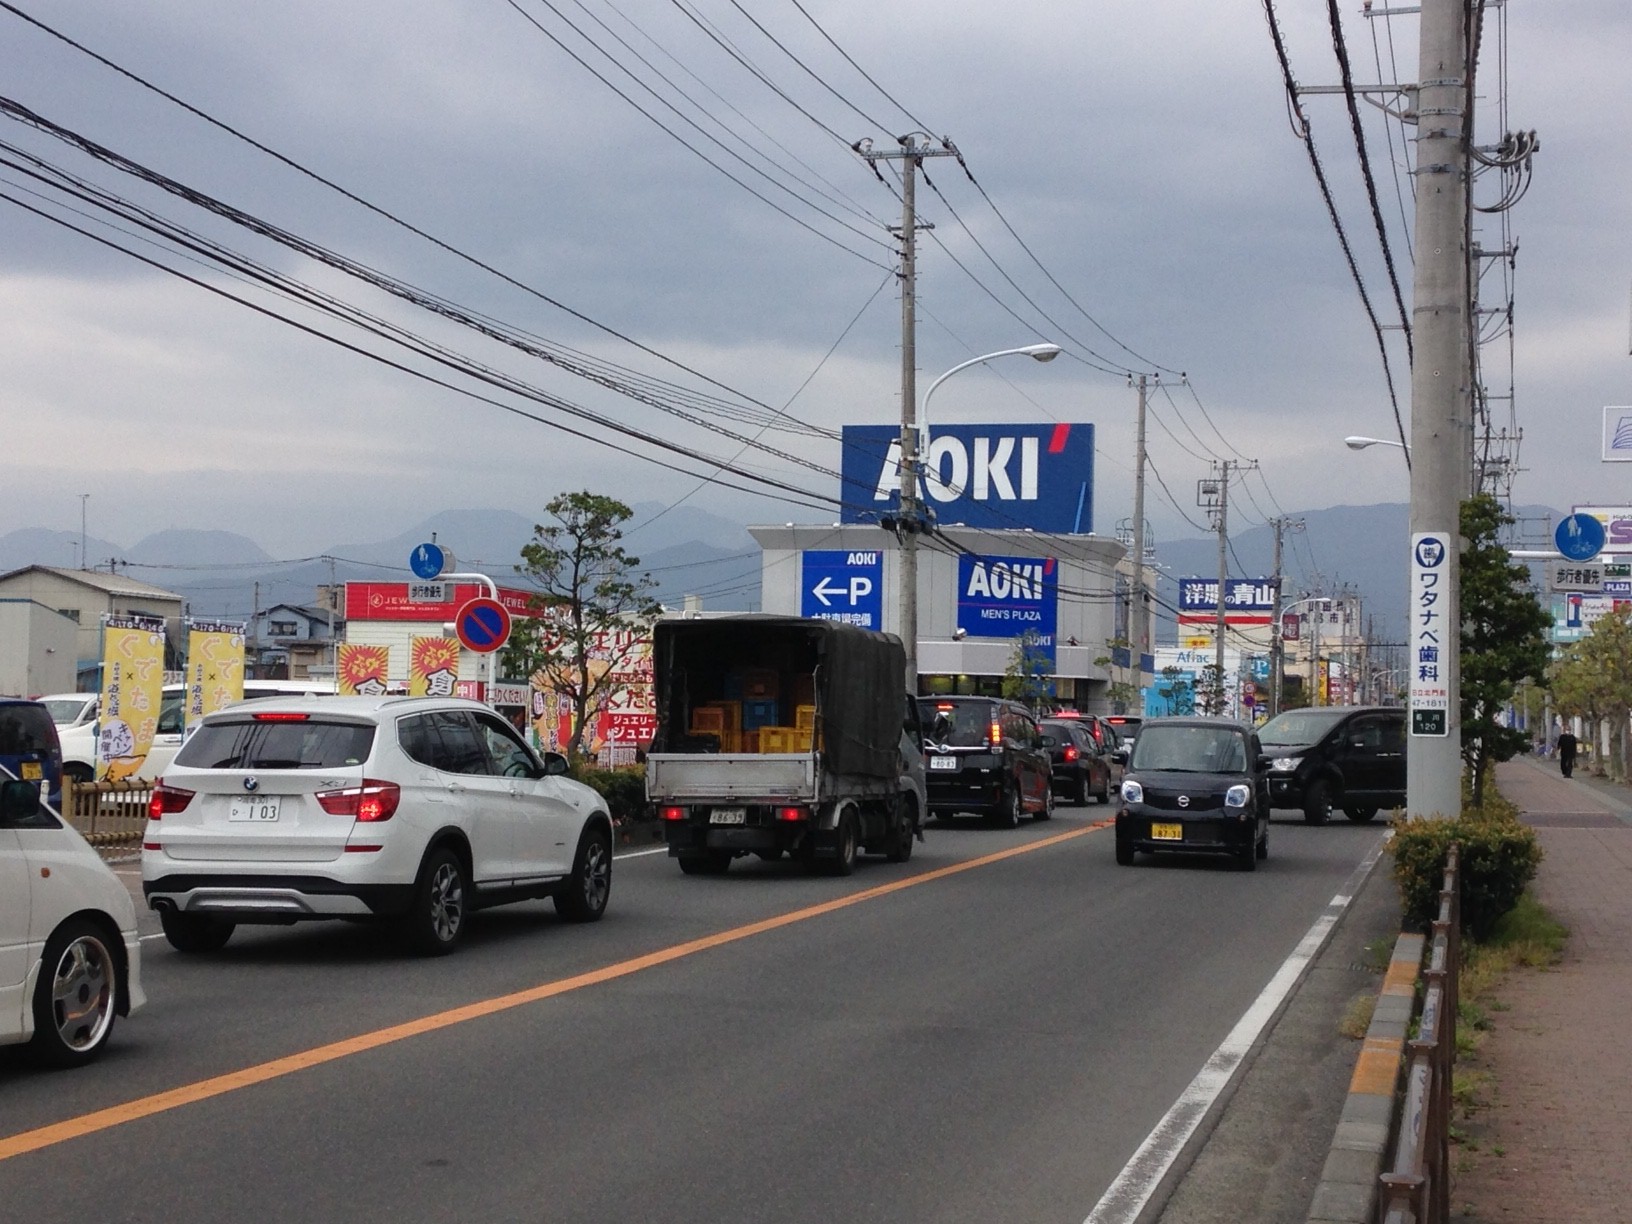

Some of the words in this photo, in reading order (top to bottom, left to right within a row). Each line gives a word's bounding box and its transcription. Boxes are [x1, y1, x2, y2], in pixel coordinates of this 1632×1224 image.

[874, 436, 1038, 502] AOKI
[847, 552, 876, 565] AOKI
[967, 562, 1042, 600] AOKI
[1556, 568, 1600, 585] 歩行者優先
[411, 585, 442, 598] 歩行者優先
[850, 577, 872, 606] P
[1184, 583, 1276, 606] 洋服の青山
[502, 597, 527, 610] JEWEL
[981, 609, 1010, 619] MEN'S
[1012, 611, 1041, 621] PLAZA
[1418, 573, 1439, 683] ワタナベ歯科
[118, 633, 158, 743] ぐでたま
[613, 716, 655, 726] ジュエリー
[1420, 723, 1437, 731] 120
